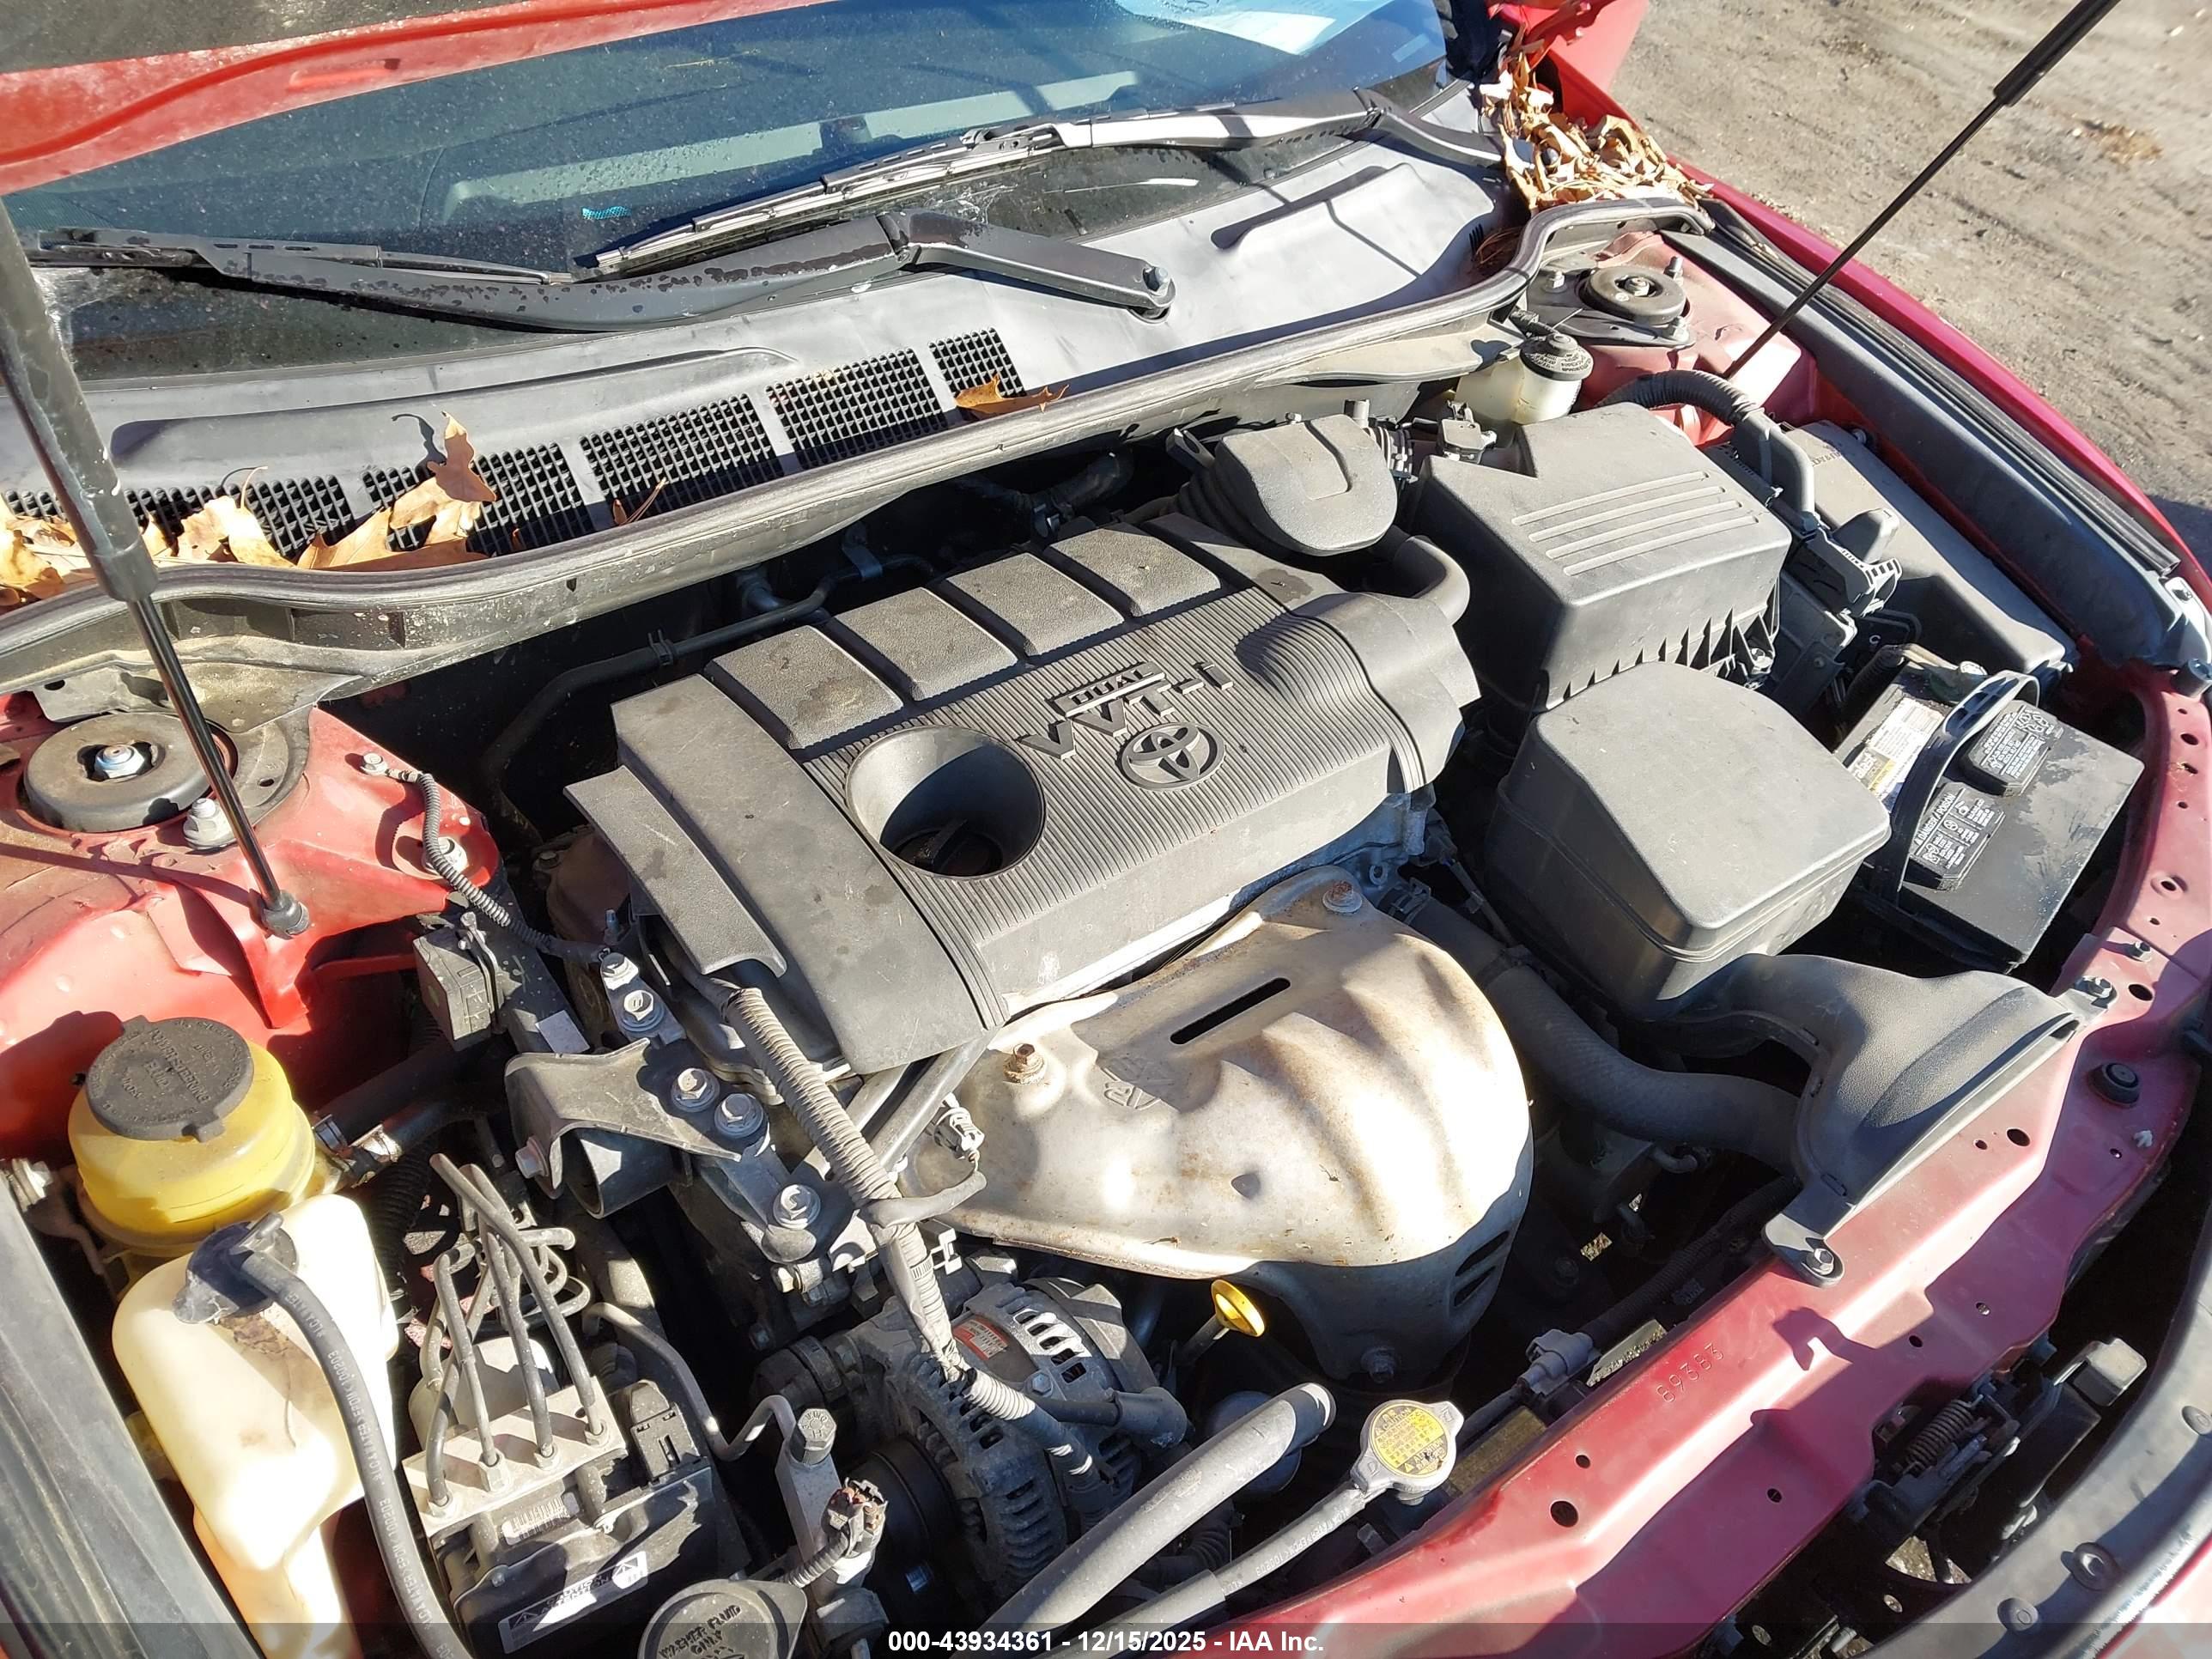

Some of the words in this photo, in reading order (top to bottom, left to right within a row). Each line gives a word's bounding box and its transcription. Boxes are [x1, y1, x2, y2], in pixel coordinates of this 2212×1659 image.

[1070, 665, 1153, 703] DUAL
[1917, 815, 1939, 840] DANGER
[1936, 792, 1955, 815] POISON
[1656, 1343, 1724, 1402] 89383
